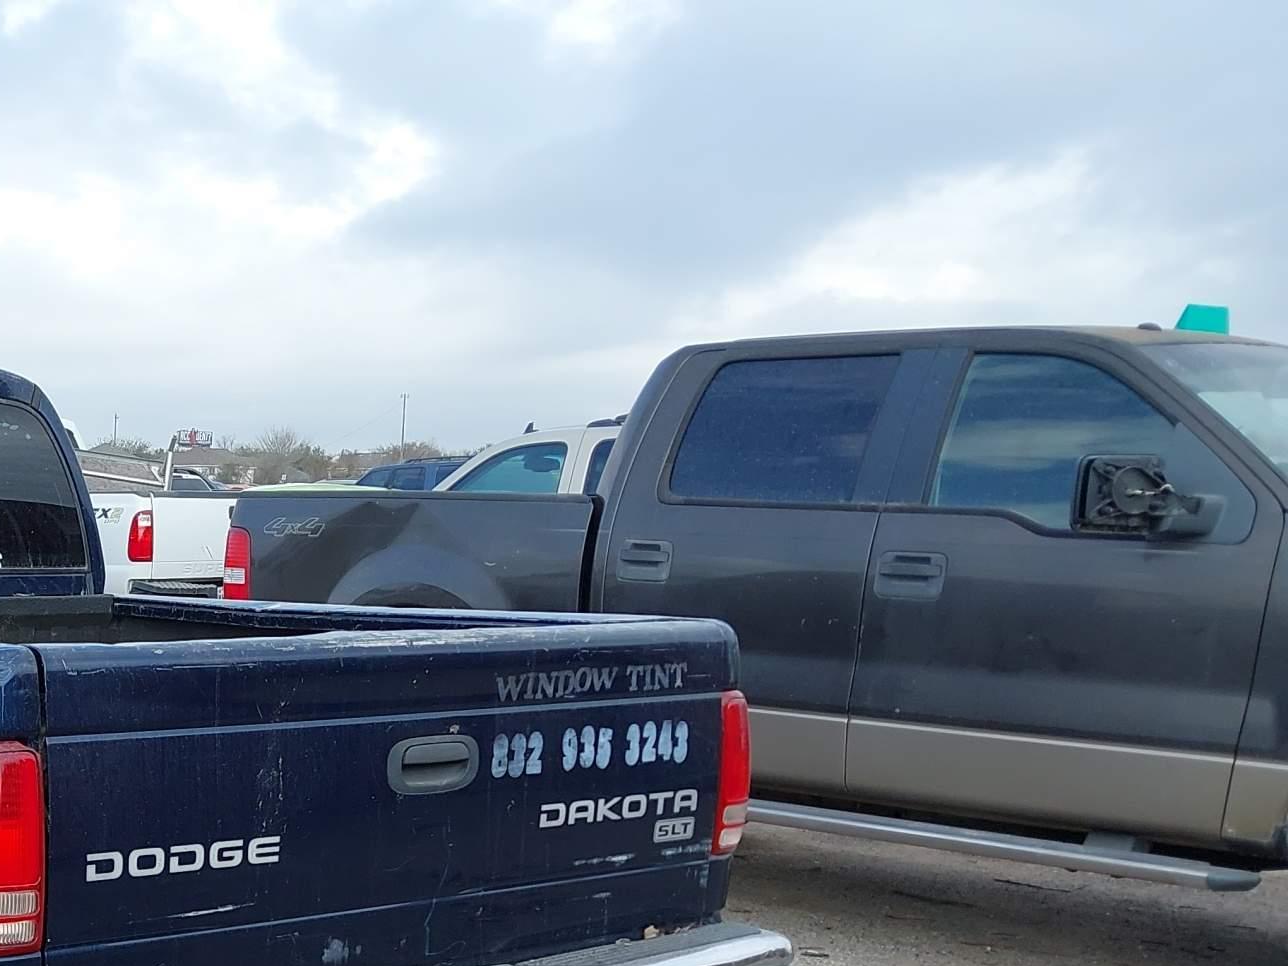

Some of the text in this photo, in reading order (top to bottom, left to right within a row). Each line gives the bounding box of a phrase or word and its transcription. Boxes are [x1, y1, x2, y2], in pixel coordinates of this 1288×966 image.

[263, 516, 326, 537] 4x4
[496, 662, 688, 701] WINDOW TINT
[491, 719, 689, 778] 832 935 3243
[539, 788, 698, 828] DAKOTA
[658, 822, 691, 837] SLT
[86, 835, 280, 882] DODGE
